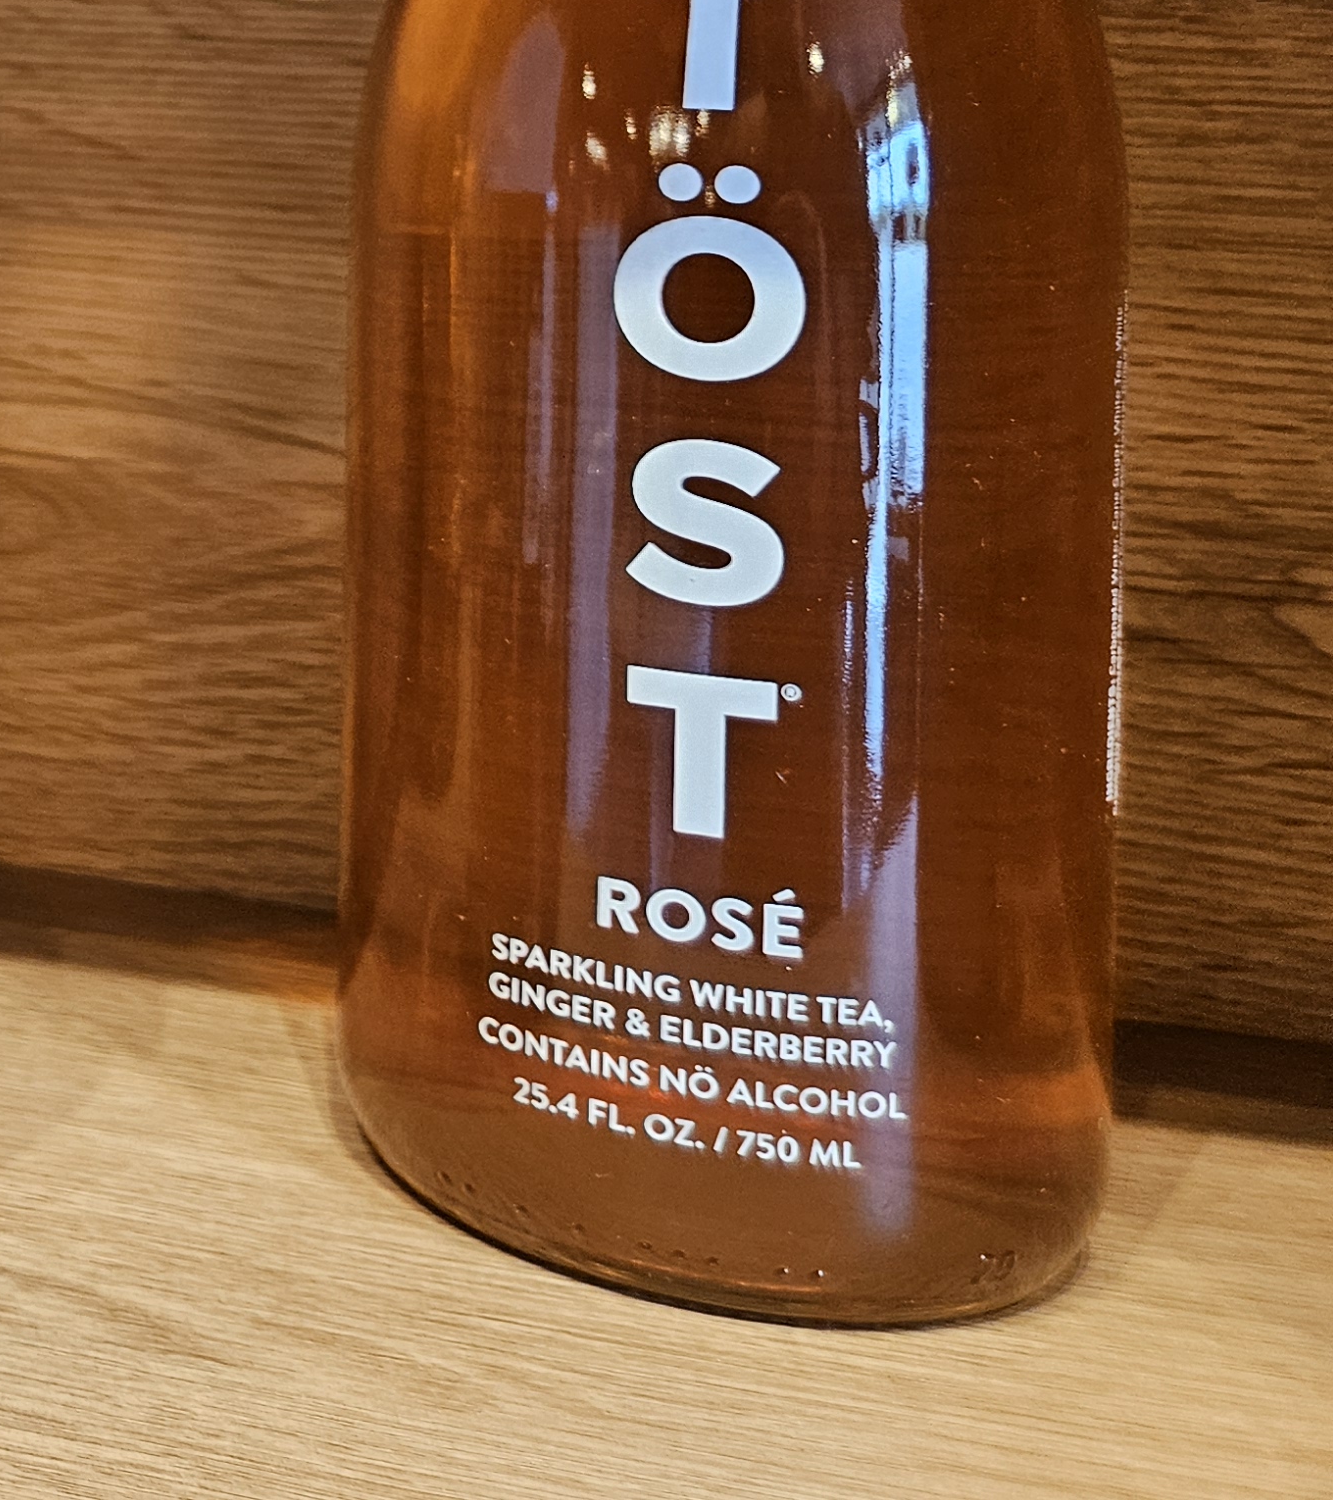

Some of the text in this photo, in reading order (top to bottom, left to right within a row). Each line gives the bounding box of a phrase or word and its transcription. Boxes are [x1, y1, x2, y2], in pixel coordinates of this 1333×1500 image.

[596, 875, 804, 959] ROSÉ
[488, 971, 897, 1069] GINGER & ELDERBERRY
[491, 933, 894, 1033] SPARKLING WHITE TEA,
[478, 1016, 908, 1120] CONTAINS NÖ ALCOHOL
[512, 1077, 863, 1170] 25.4 FL. OZ. / 750 ML
